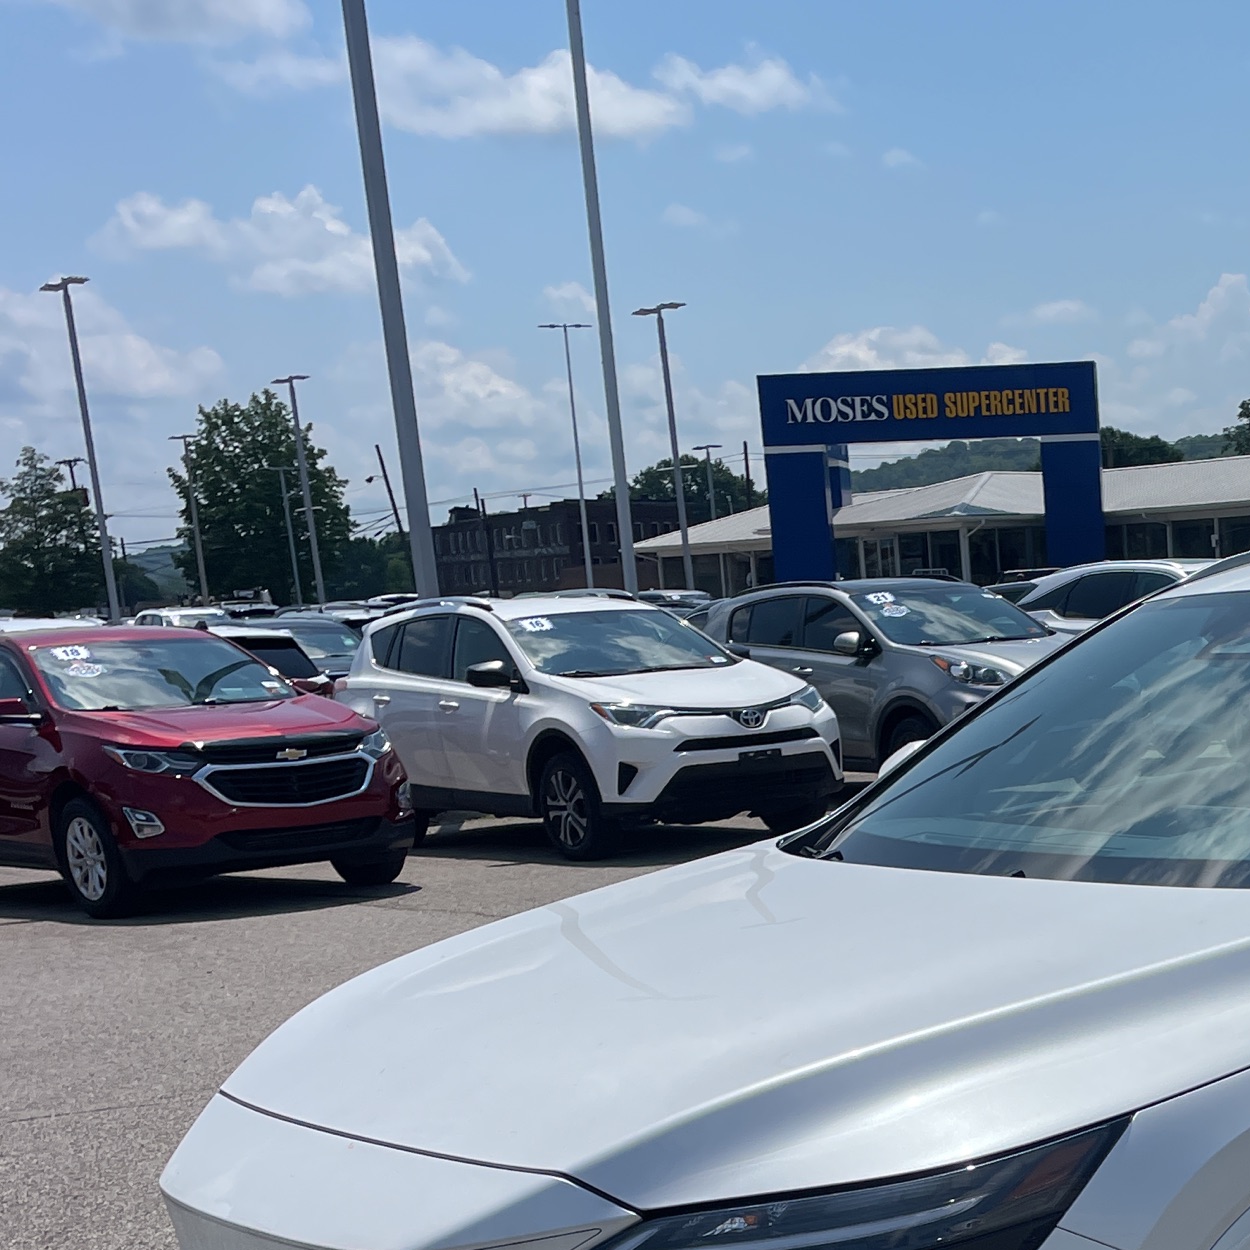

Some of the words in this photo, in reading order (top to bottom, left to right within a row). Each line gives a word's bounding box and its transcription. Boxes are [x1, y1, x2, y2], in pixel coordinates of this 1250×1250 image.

[786, 395, 888, 424] MOSES
[892, 393, 938, 420] USED
[945, 387, 1070, 418] SUPERCENTER
[873, 594, 889, 602] 21
[529, 620, 544, 628] 16
[62, 649, 80, 657] 18
